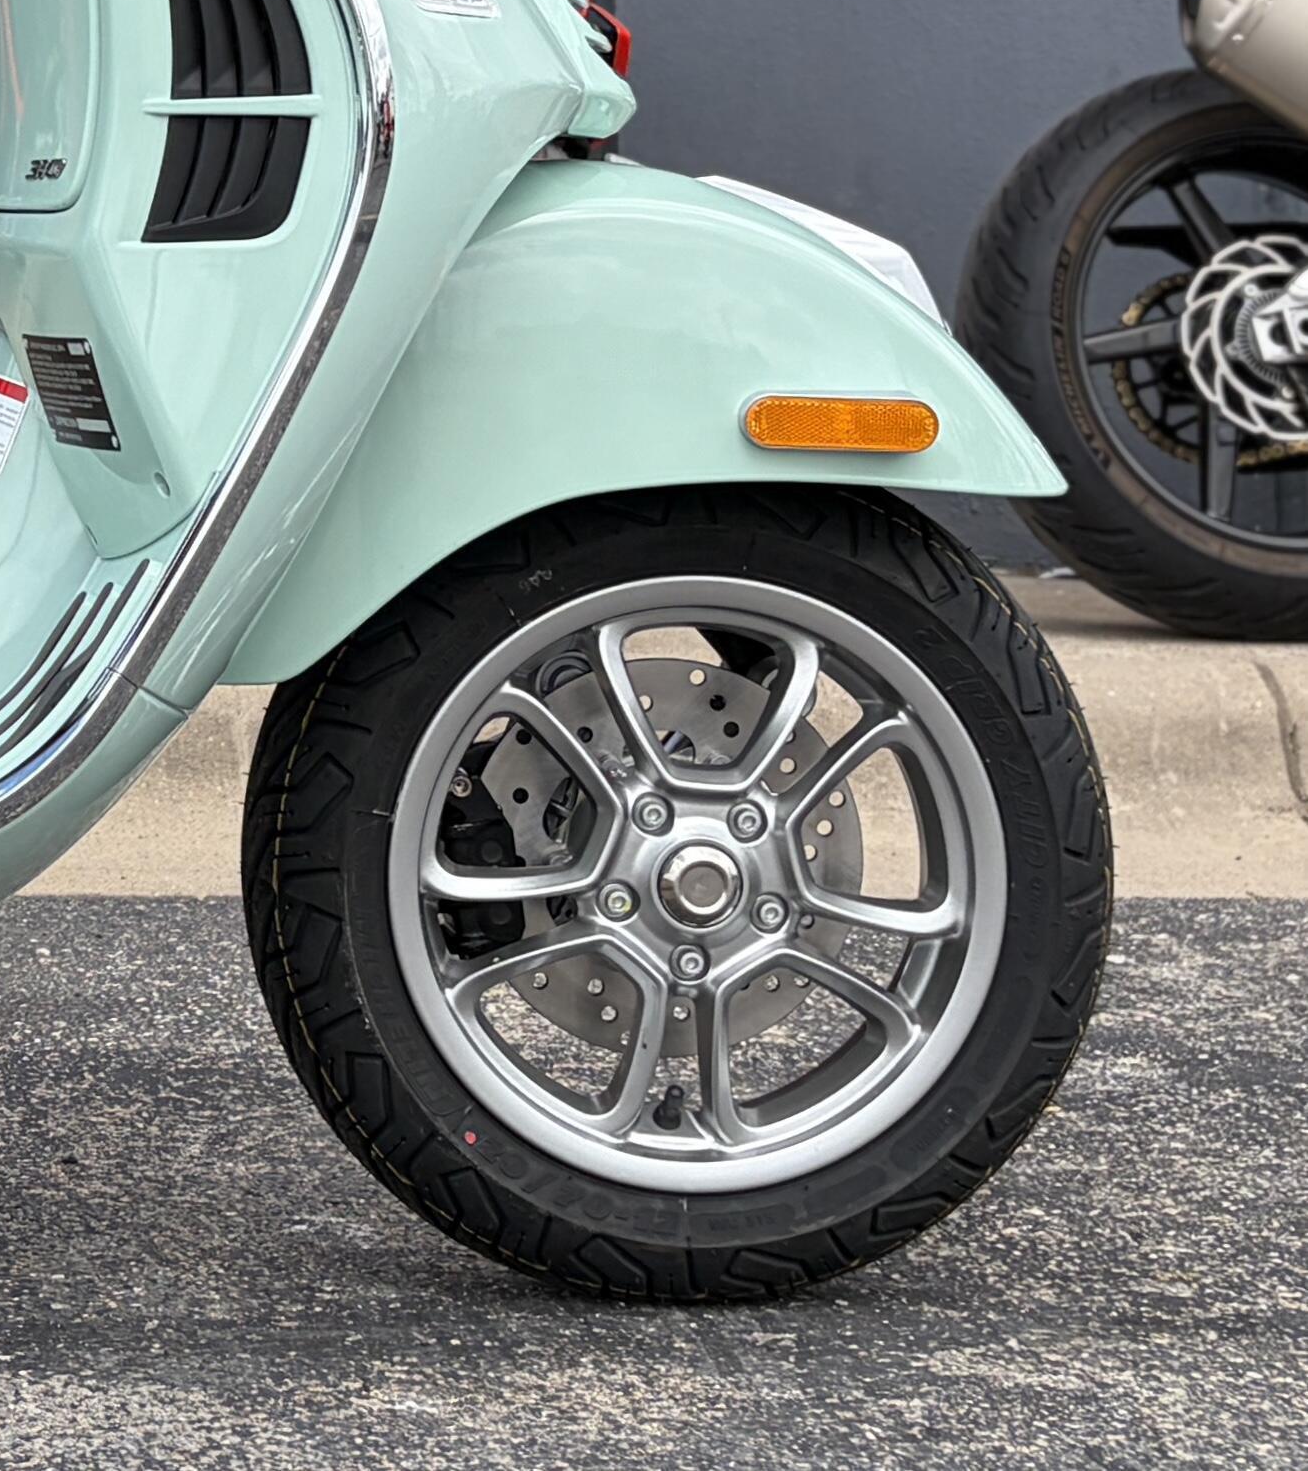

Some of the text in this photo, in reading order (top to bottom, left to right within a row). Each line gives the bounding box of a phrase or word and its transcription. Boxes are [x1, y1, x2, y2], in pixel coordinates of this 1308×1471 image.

[912, 626, 949, 650] 2
[939, 655, 1017, 747] GRIP
[999, 757, 1049, 869] CITY
